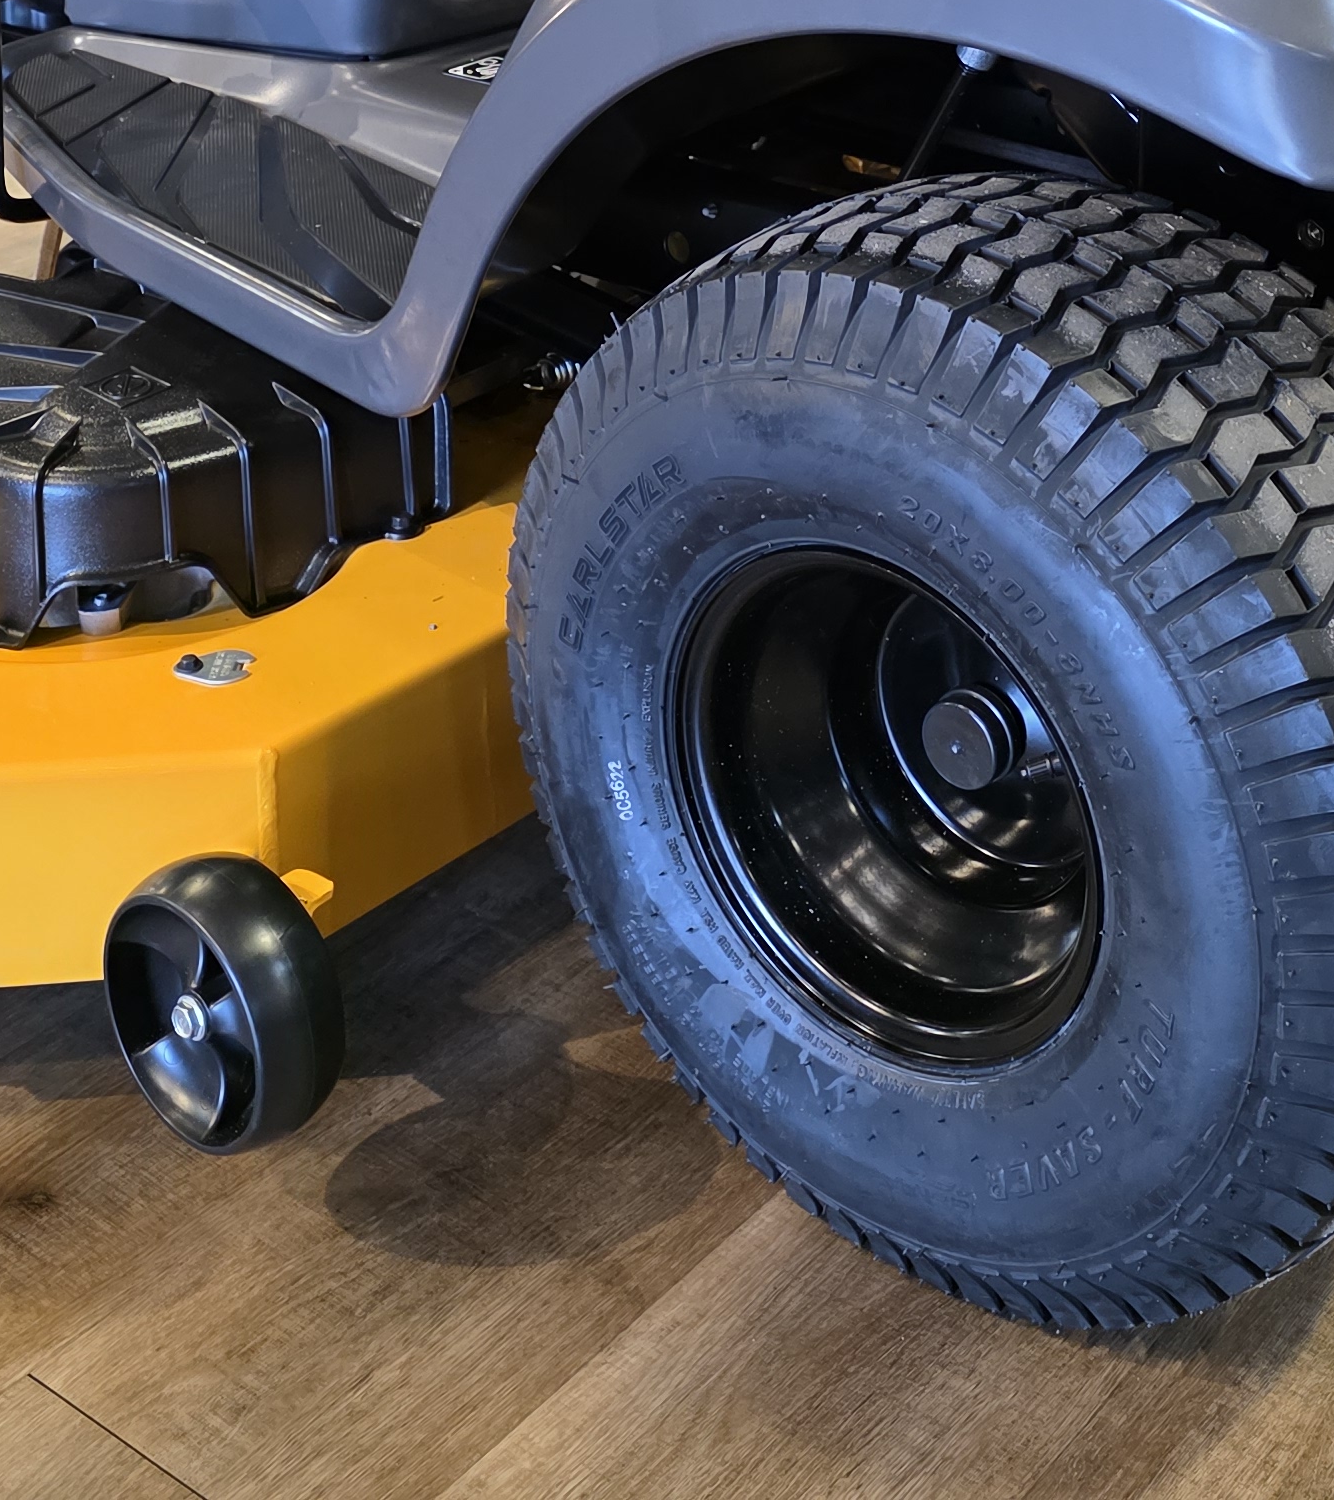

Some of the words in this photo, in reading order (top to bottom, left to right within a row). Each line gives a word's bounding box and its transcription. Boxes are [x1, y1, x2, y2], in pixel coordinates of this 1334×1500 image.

[558, 454, 687, 653] CARLSTAR
[641, 664, 656, 723] EXPLOSION
[651, 782, 672, 831] SERIOUS
[667, 837, 688, 876] CAUSE
[684, 880, 703, 905] MAY
[717, 934, 745, 971] RATED
[765, 996, 793, 1027] OVER
[795, 1024, 849, 1067] INFLATION
